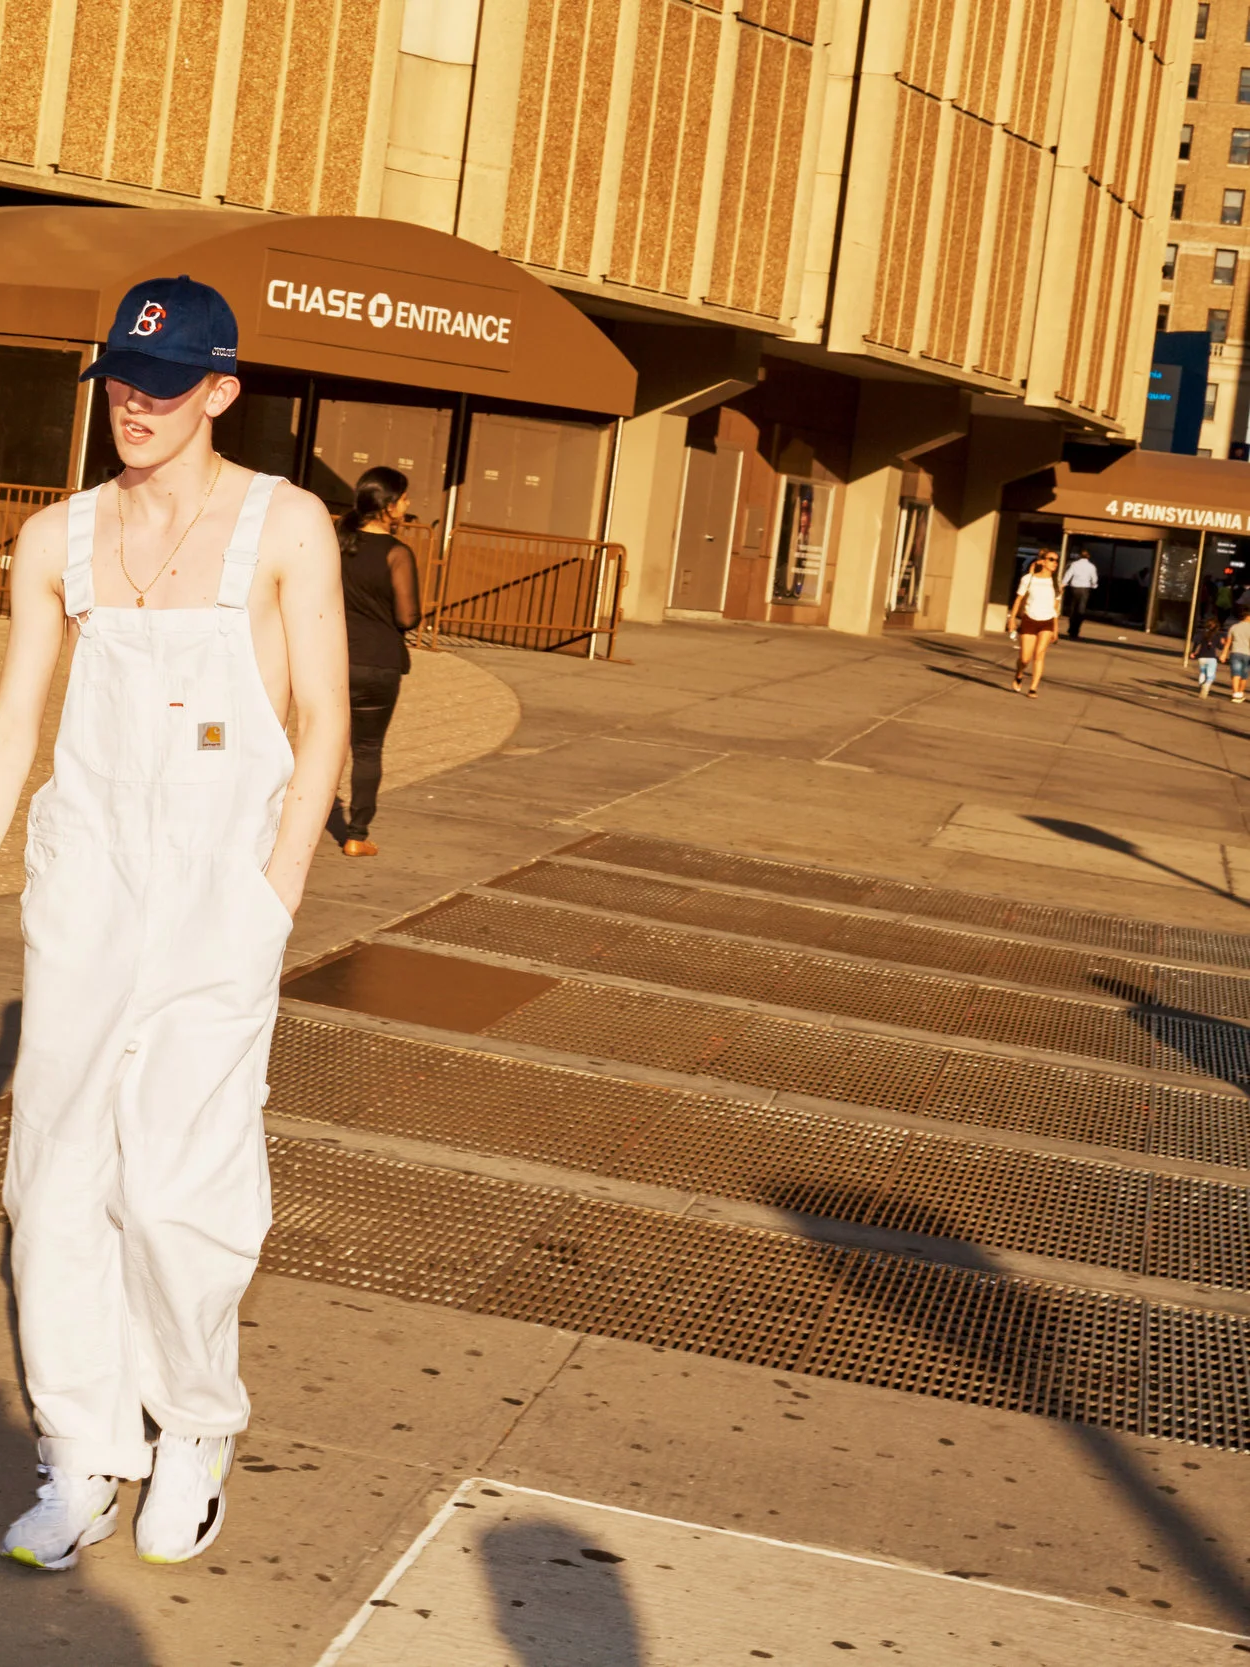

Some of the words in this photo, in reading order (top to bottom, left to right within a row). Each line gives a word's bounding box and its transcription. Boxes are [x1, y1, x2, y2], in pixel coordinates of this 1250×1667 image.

[267, 279, 366, 321] CHASE
[394, 301, 512, 344] ENTRANCE
[1105, 500, 1118, 516] 4
[1122, 501, 1242, 531] PENNSYLVANIA
